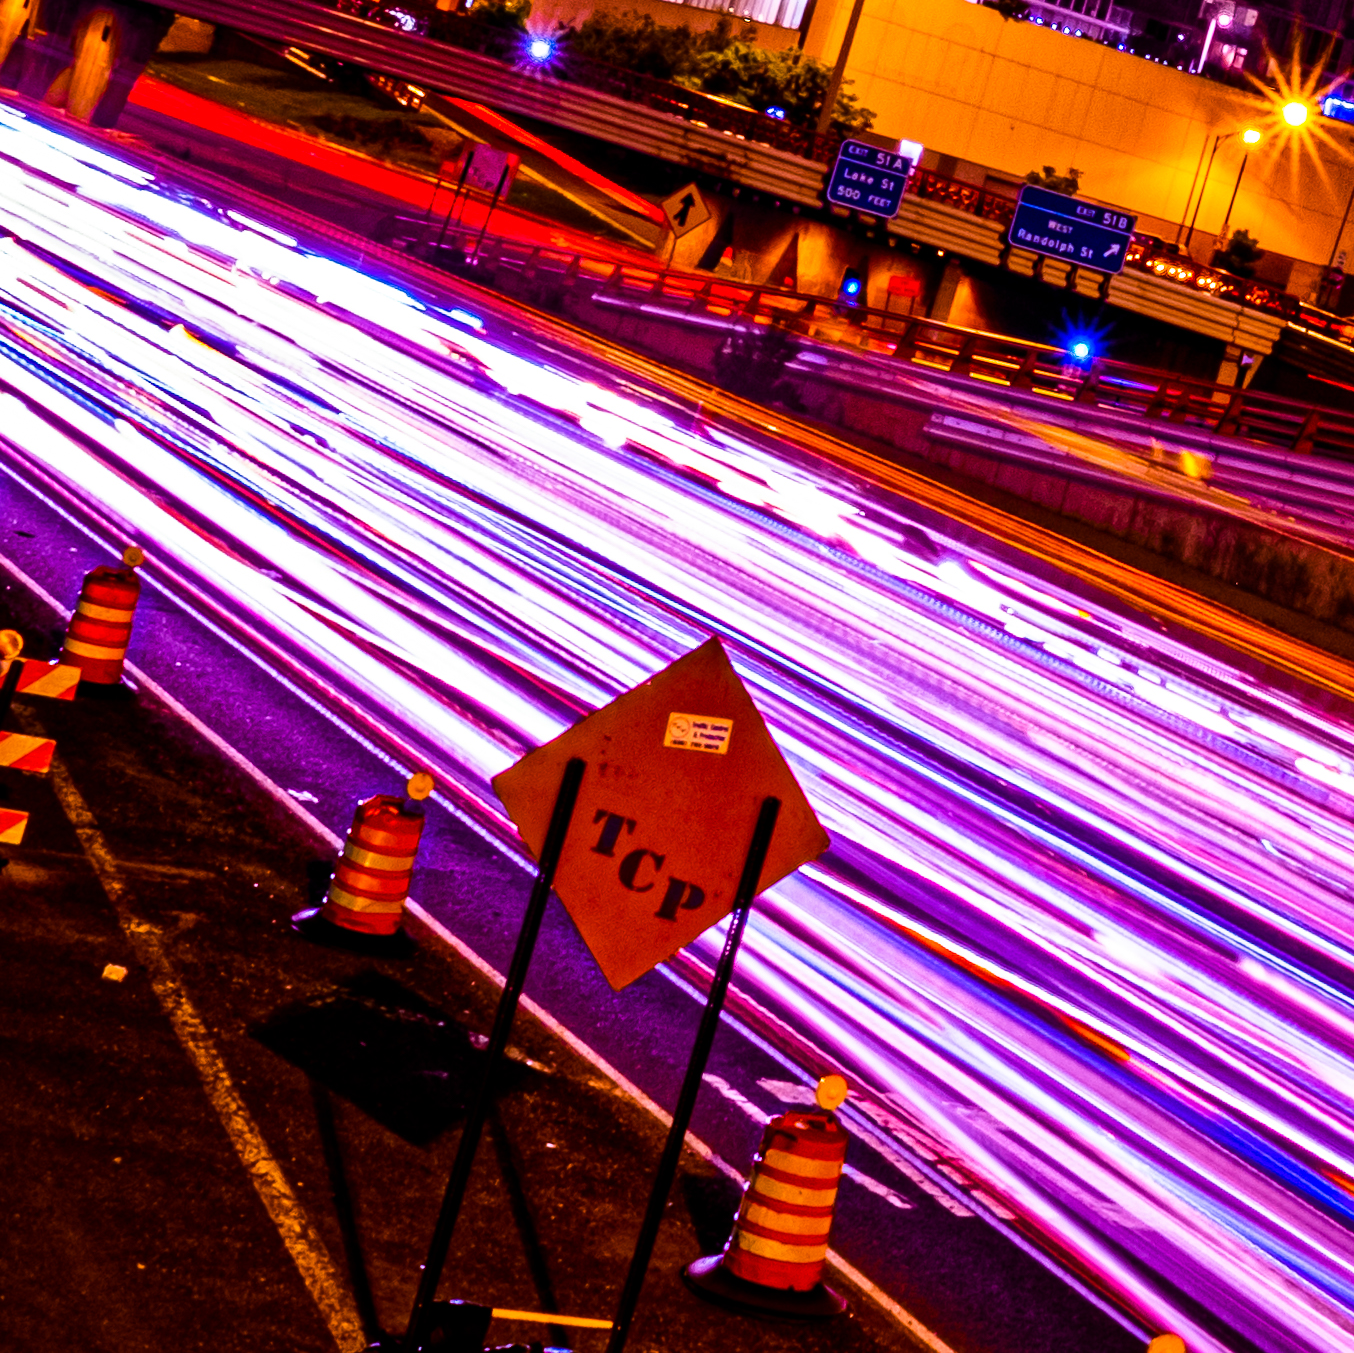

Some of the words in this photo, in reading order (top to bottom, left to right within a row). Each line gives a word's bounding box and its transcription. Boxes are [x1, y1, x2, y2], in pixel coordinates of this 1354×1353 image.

[876, 152, 903, 170] 51A
[844, 167, 875, 186] Lake
[881, 178, 895, 192] St
[837, 184, 862, 200] 500
[867, 194, 892, 208] FEET
[1047, 219, 1074, 234] WEST
[1102, 212, 1128, 229] 51B
[1017, 227, 1075, 253] Randolph
[1080, 246, 1094, 260] St
[590, 809, 705, 923] TCP
